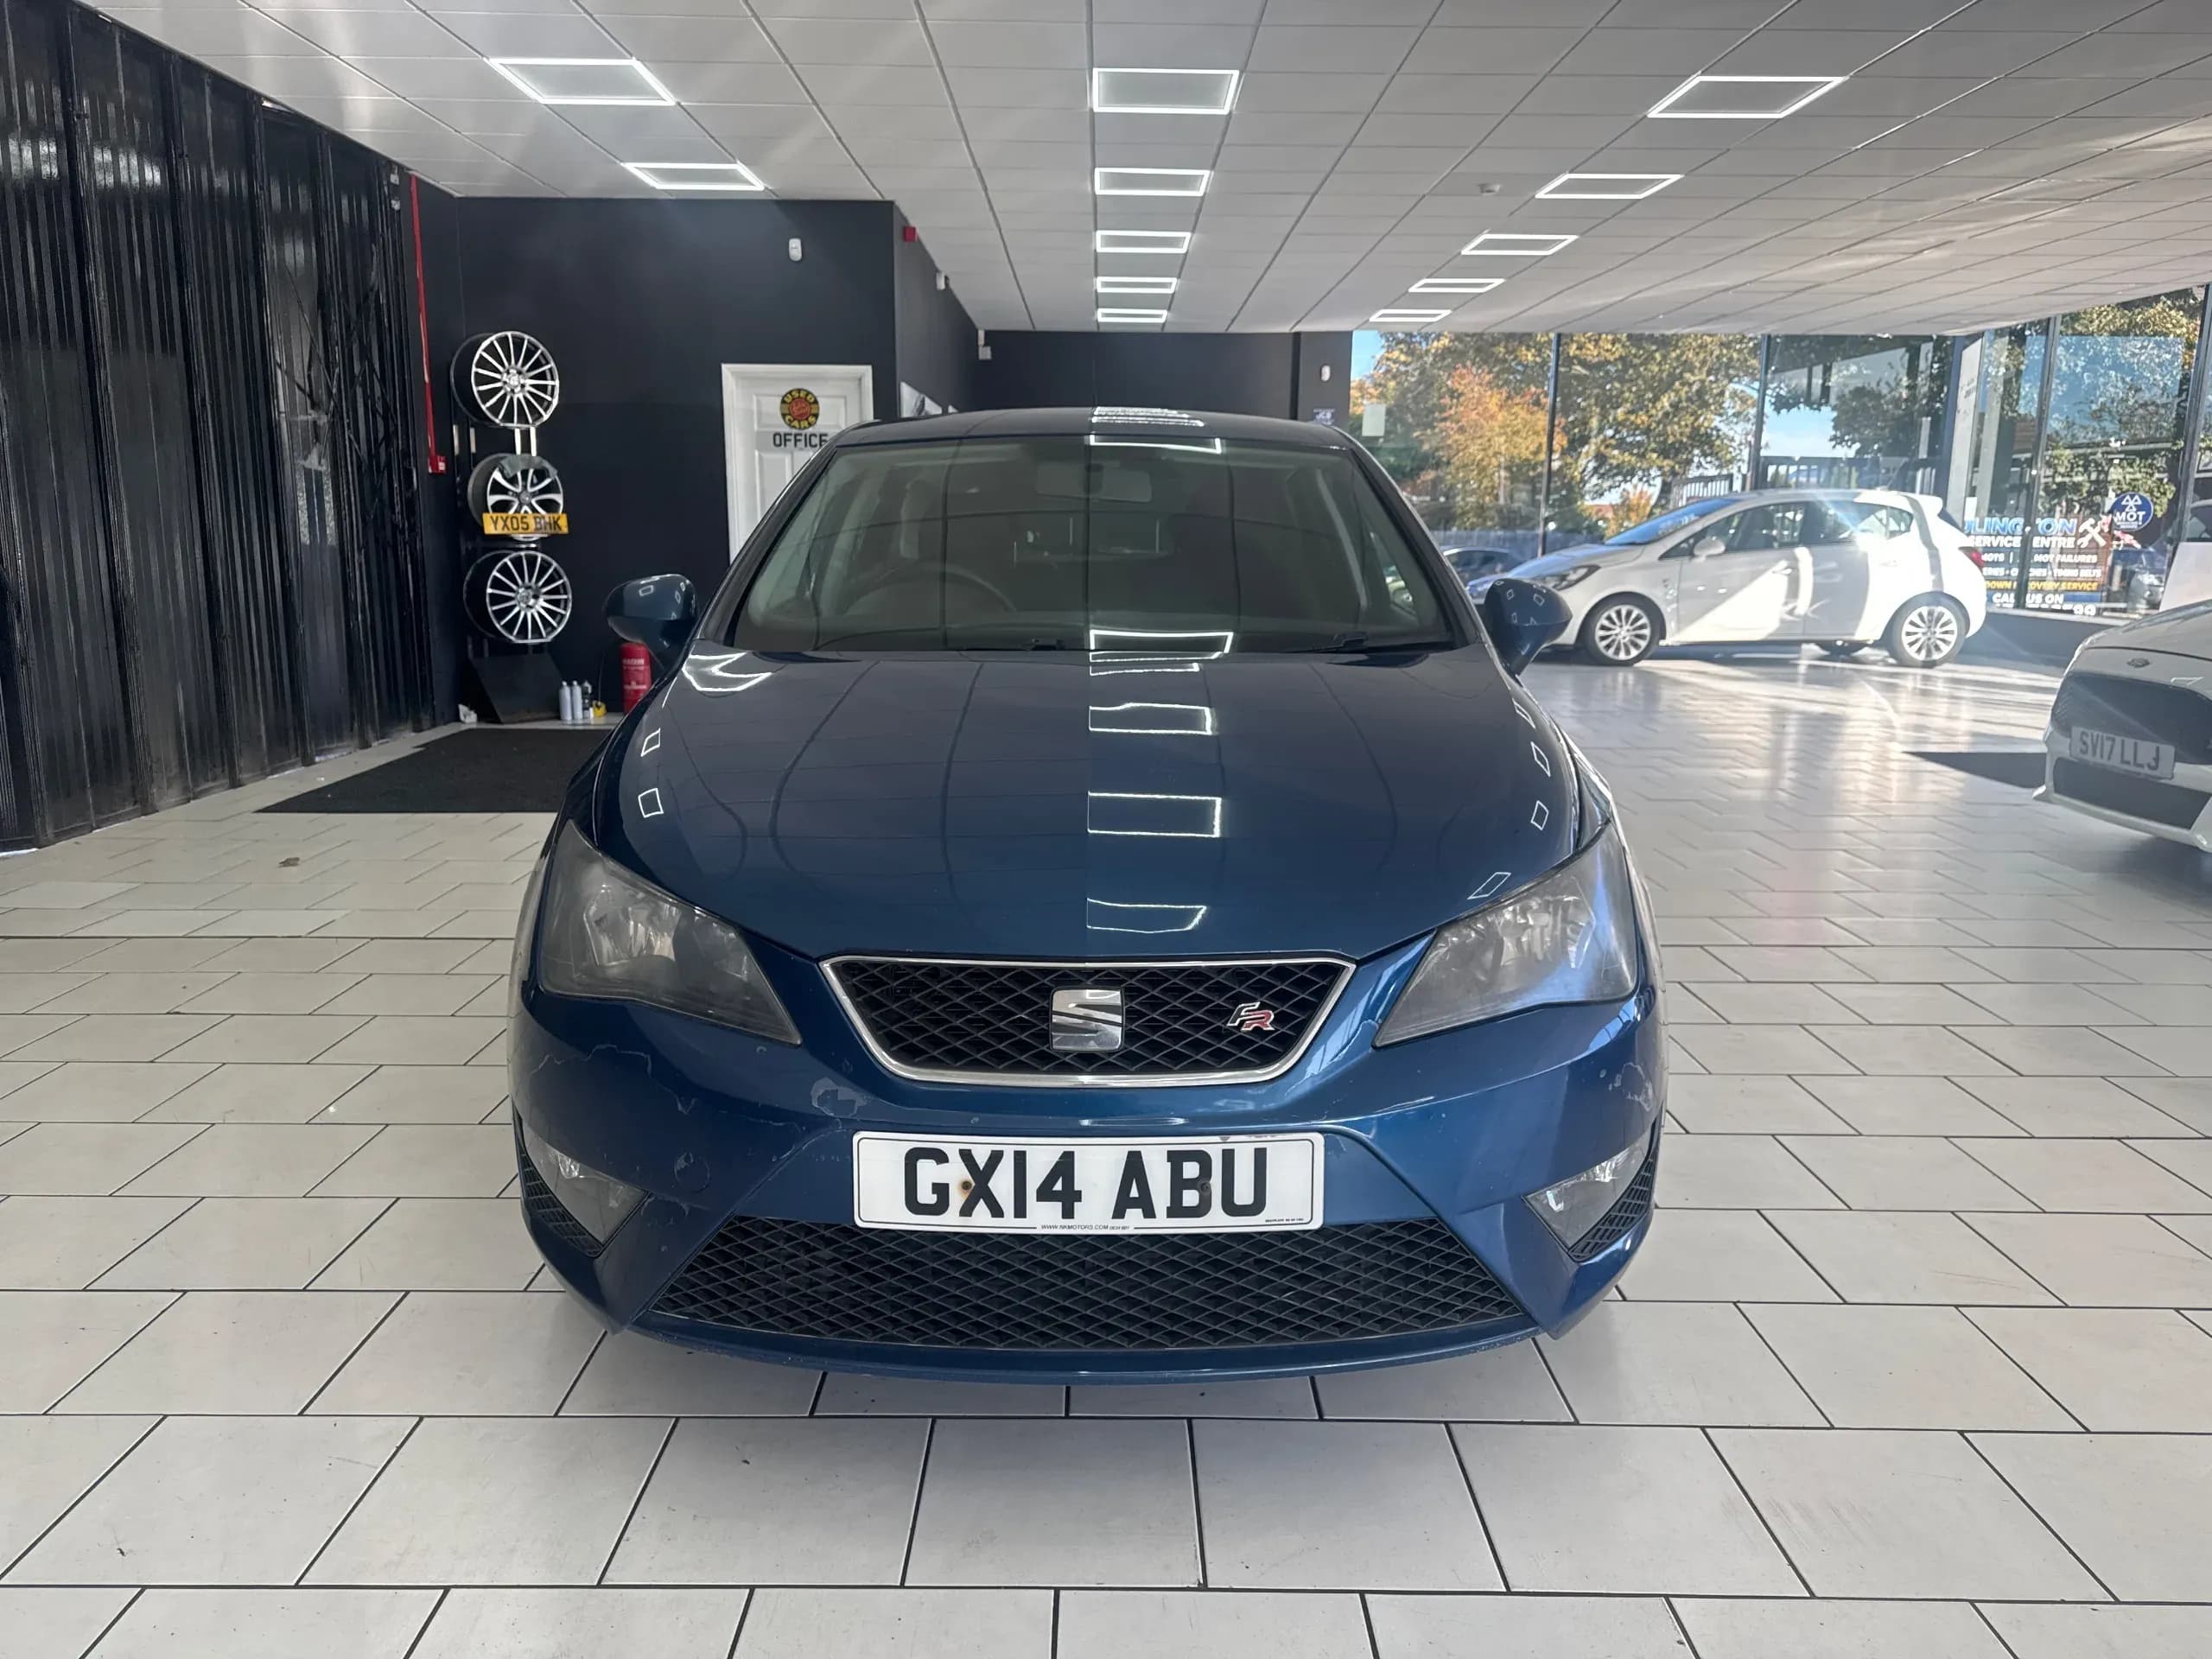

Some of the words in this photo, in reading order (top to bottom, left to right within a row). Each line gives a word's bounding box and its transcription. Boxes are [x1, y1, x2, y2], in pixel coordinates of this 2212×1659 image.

[784, 390, 815, 403] USED
[785, 415, 817, 429] CARS
[773, 433, 829, 448] OFFICE
[490, 515, 530, 531] YX05
[533, 515, 563, 531] BHK
[2115, 511, 2146, 523] MOT
[2032, 536, 2075, 548] ENTRE
[2061, 582, 2098, 591] SERVICE
[2026, 593, 2044, 604] US
[2044, 593, 2064, 604] ON
[2079, 731, 2116, 760] SV17
[2120, 739, 2160, 772] LLJ
[904, 1147, 1082, 1220] GX14
[1111, 1147, 1268, 1219] ABU
